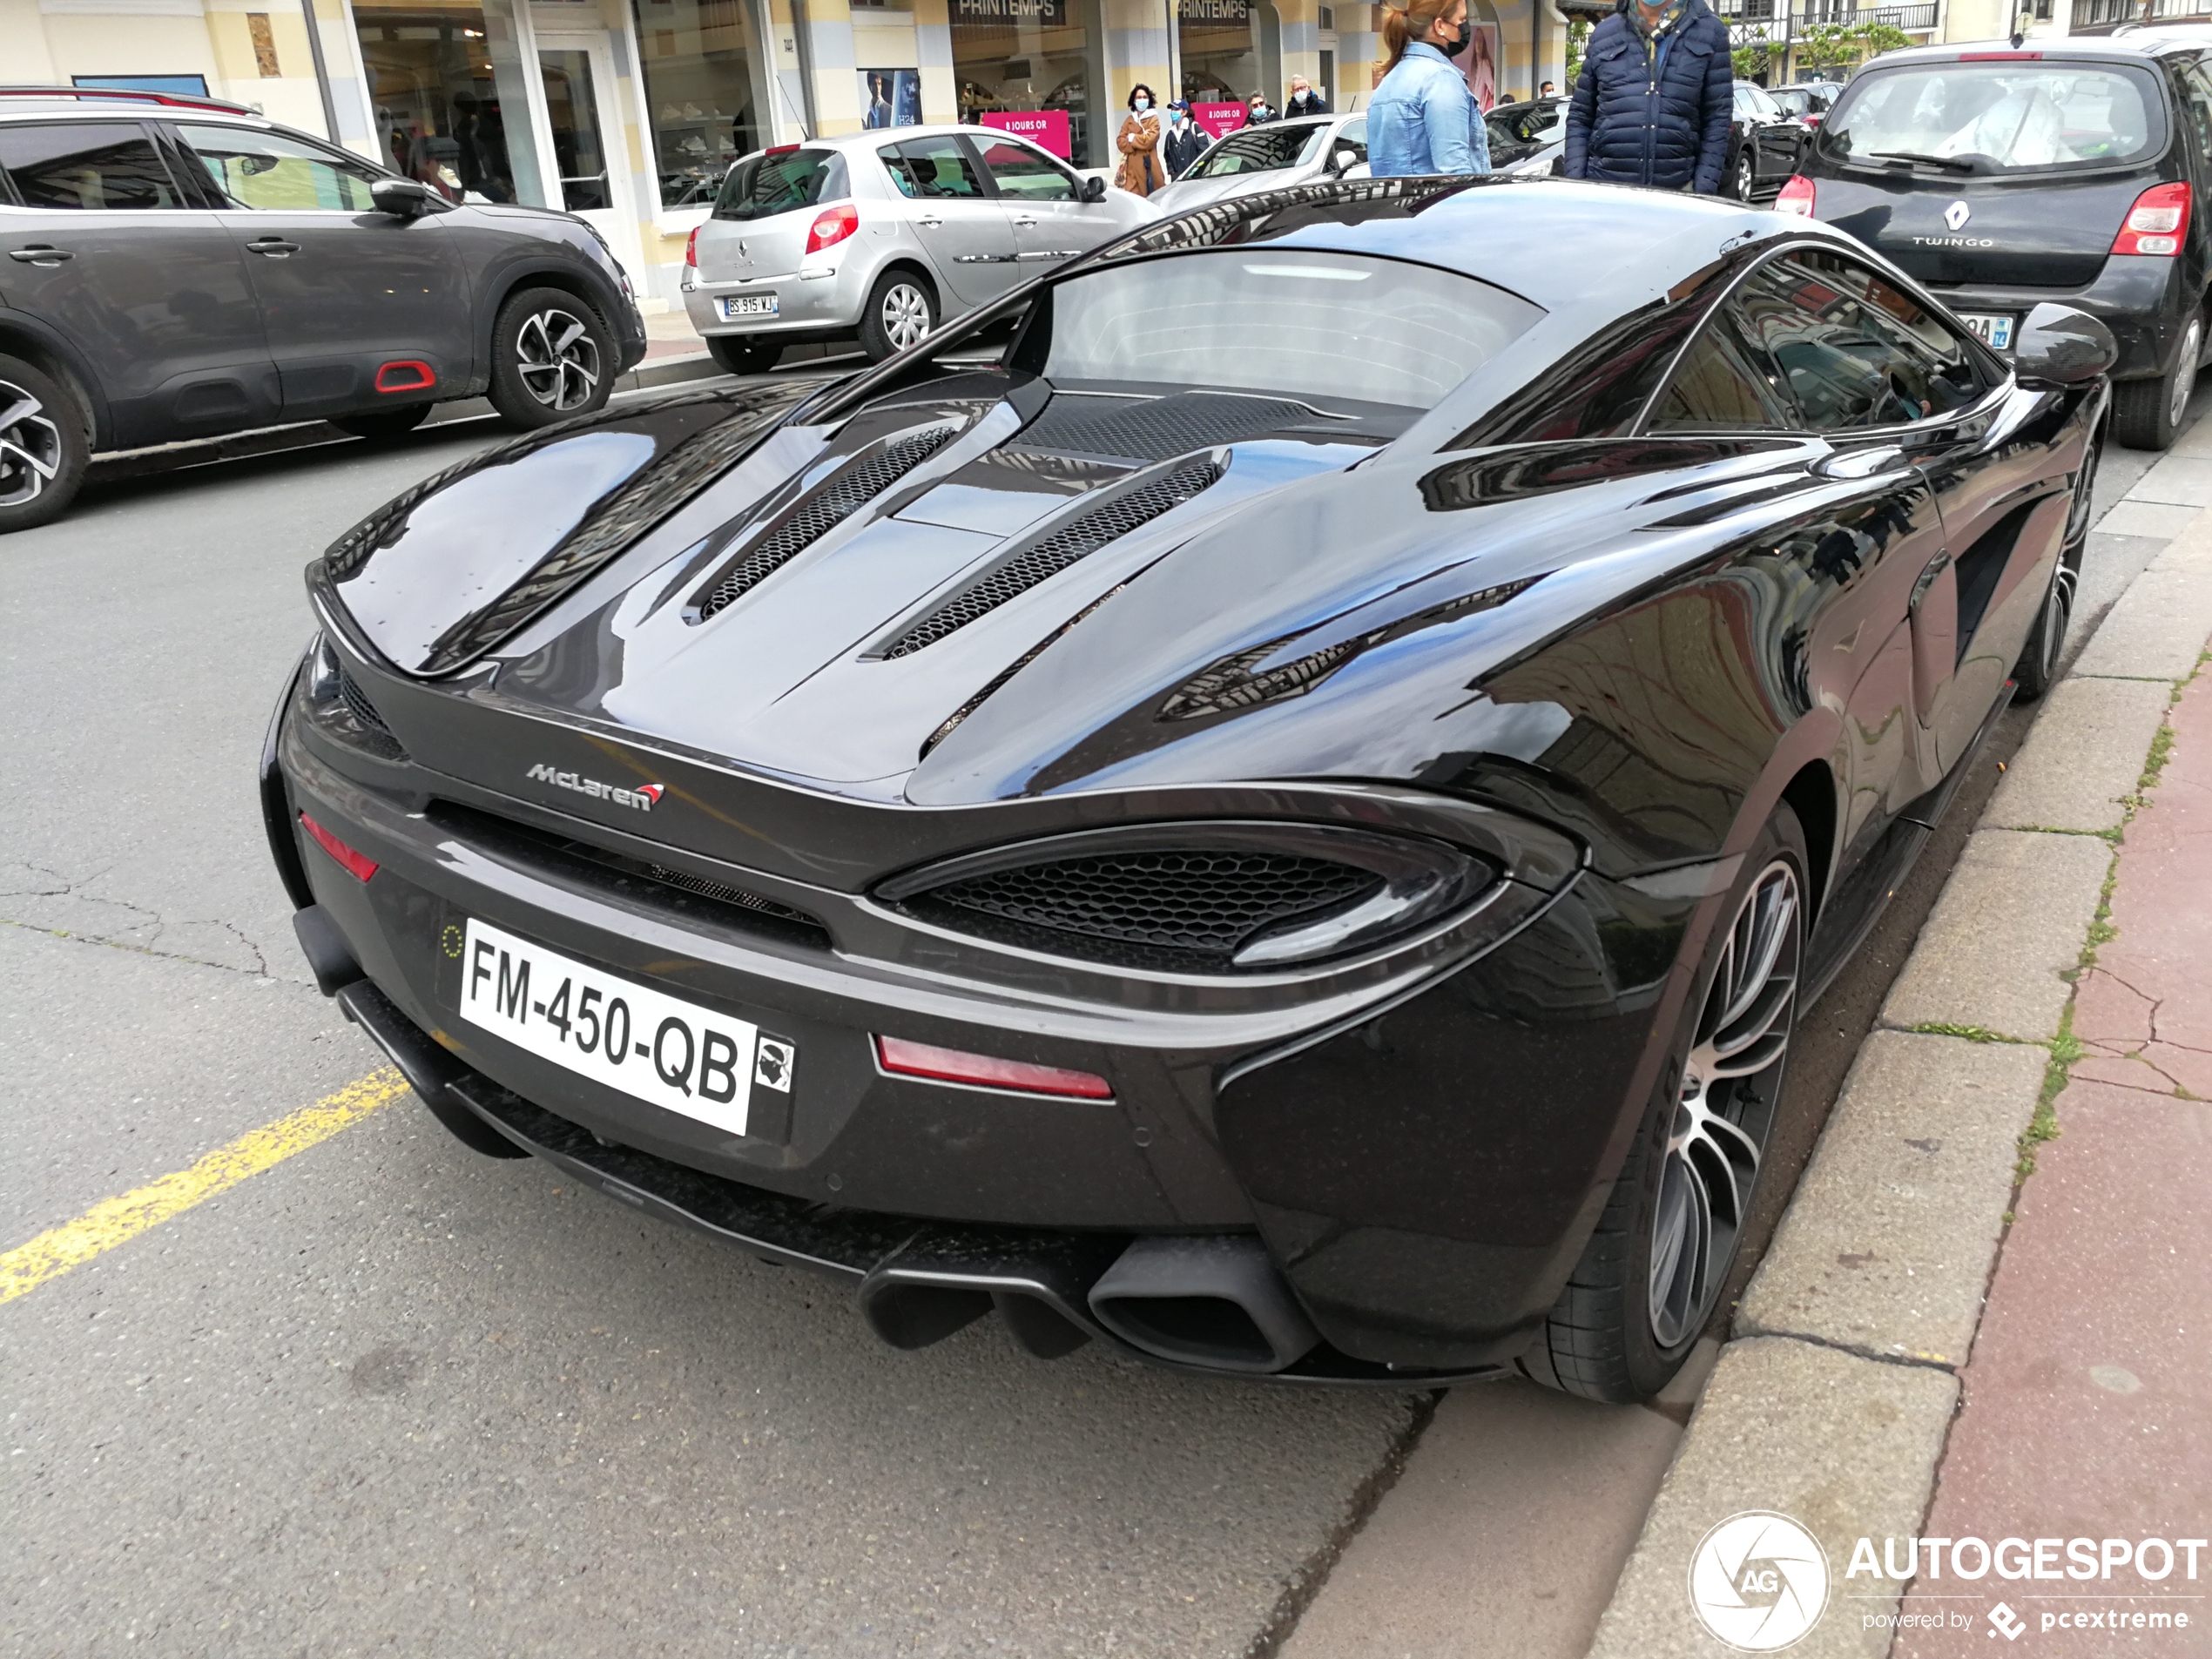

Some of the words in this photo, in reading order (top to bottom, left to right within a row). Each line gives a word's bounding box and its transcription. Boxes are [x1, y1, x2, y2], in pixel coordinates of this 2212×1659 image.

[960, 0, 1055, 16] PRINTEMPS
[899, 115, 915, 125] H24
[1213, 110, 1231, 118] JOURS
[1006, 121, 1010, 131] 8
[1012, 120, 1035, 131] JOURS
[1035, 119, 1047, 130] OR
[1912, 237, 1993, 247] TWINGO
[526, 764, 651, 812] McLaren
[470, 938, 738, 1105] FM-450-QB
